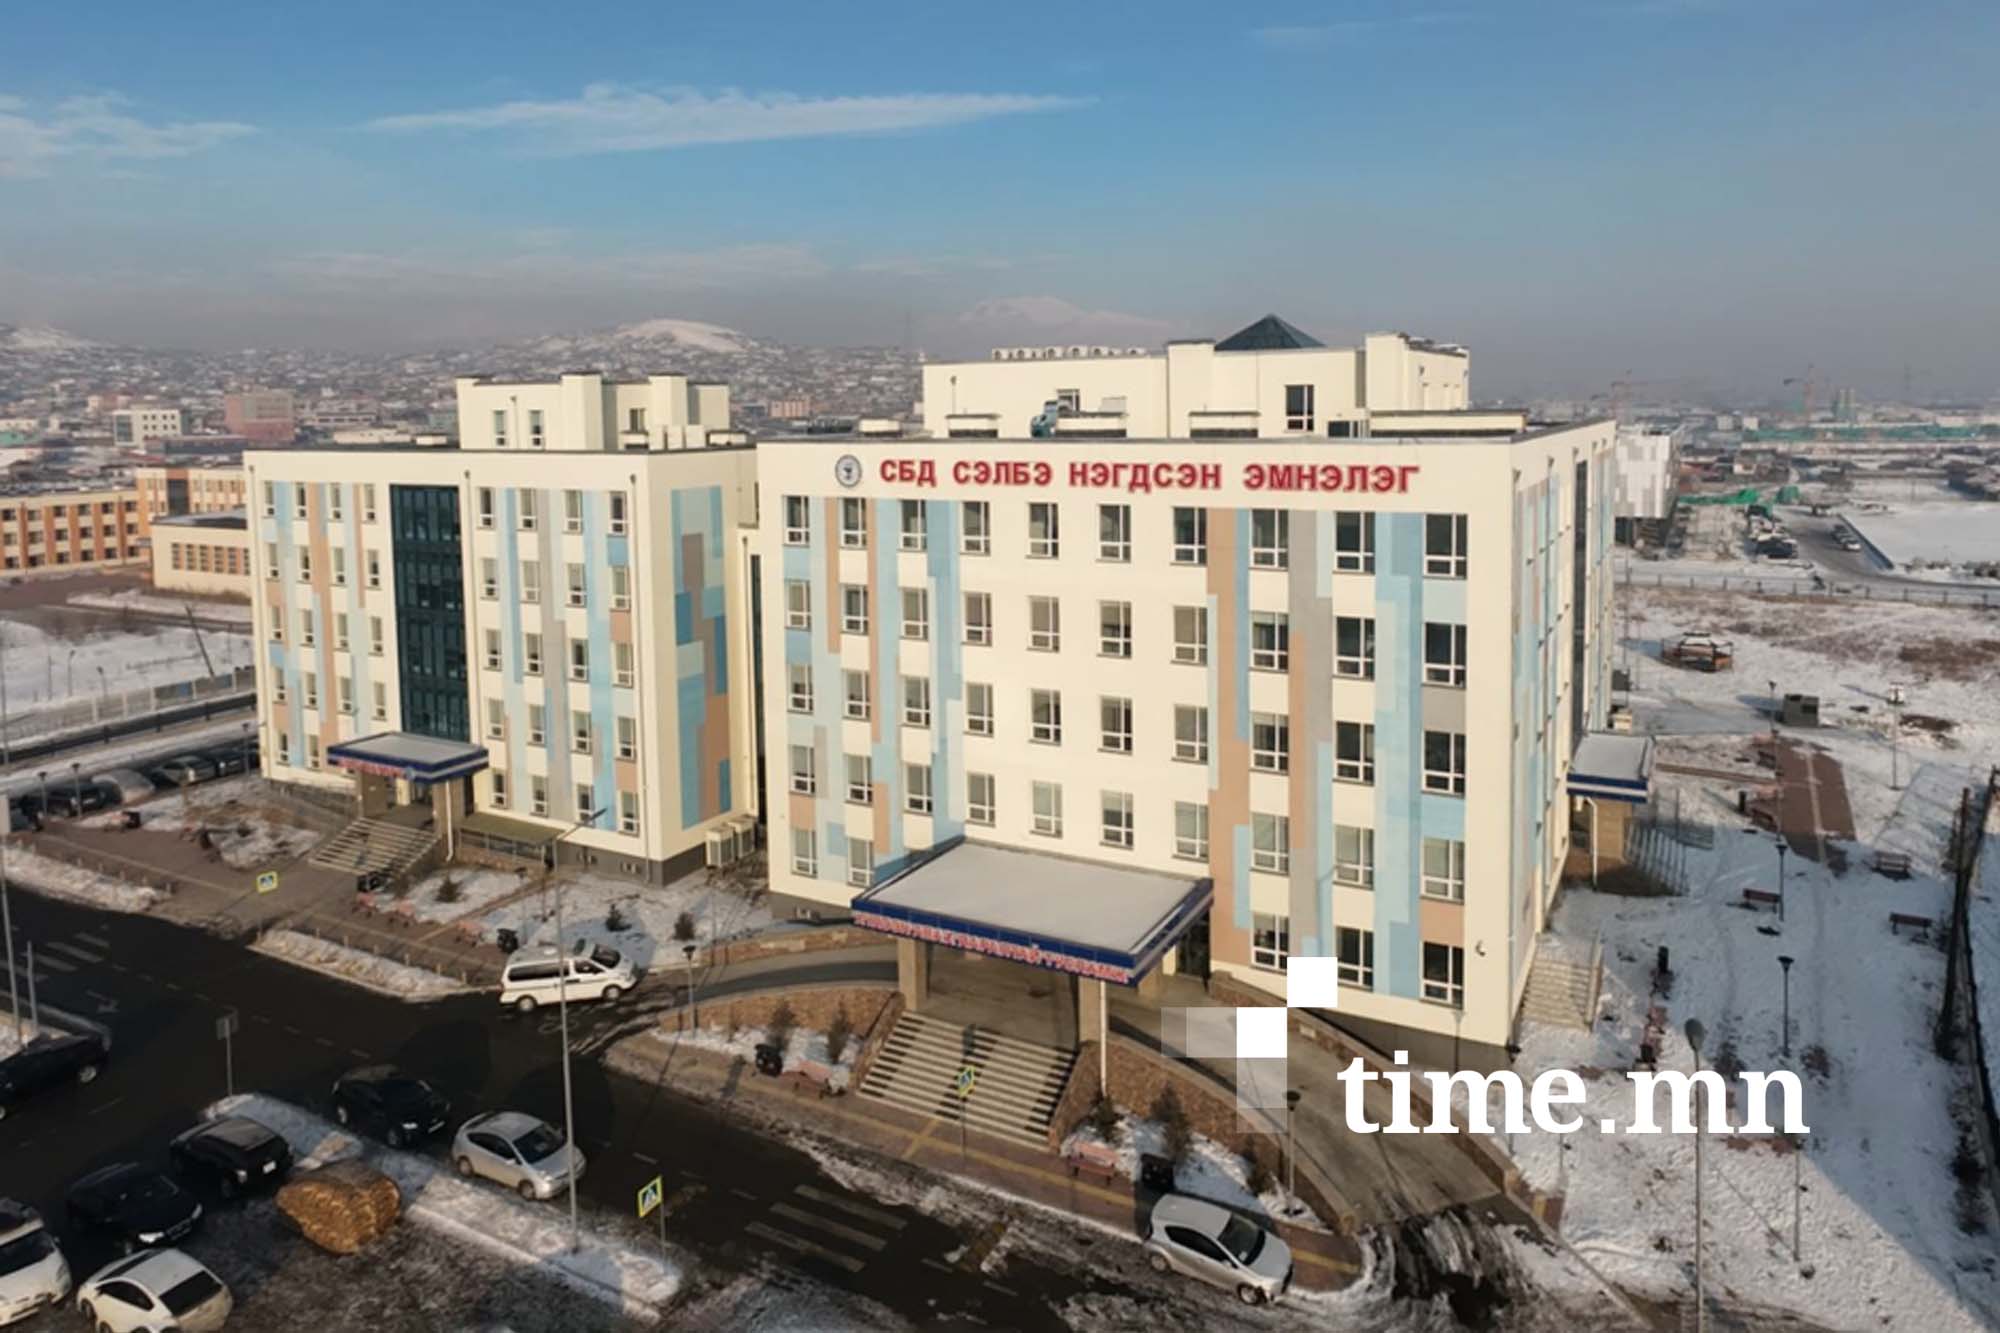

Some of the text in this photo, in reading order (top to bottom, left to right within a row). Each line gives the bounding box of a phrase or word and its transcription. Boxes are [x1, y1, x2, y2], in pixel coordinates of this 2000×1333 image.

[880, 458, 1418, 494] СБД СЭЛБЭ НЭГДСЭН ЭМНЭЛЭГ
